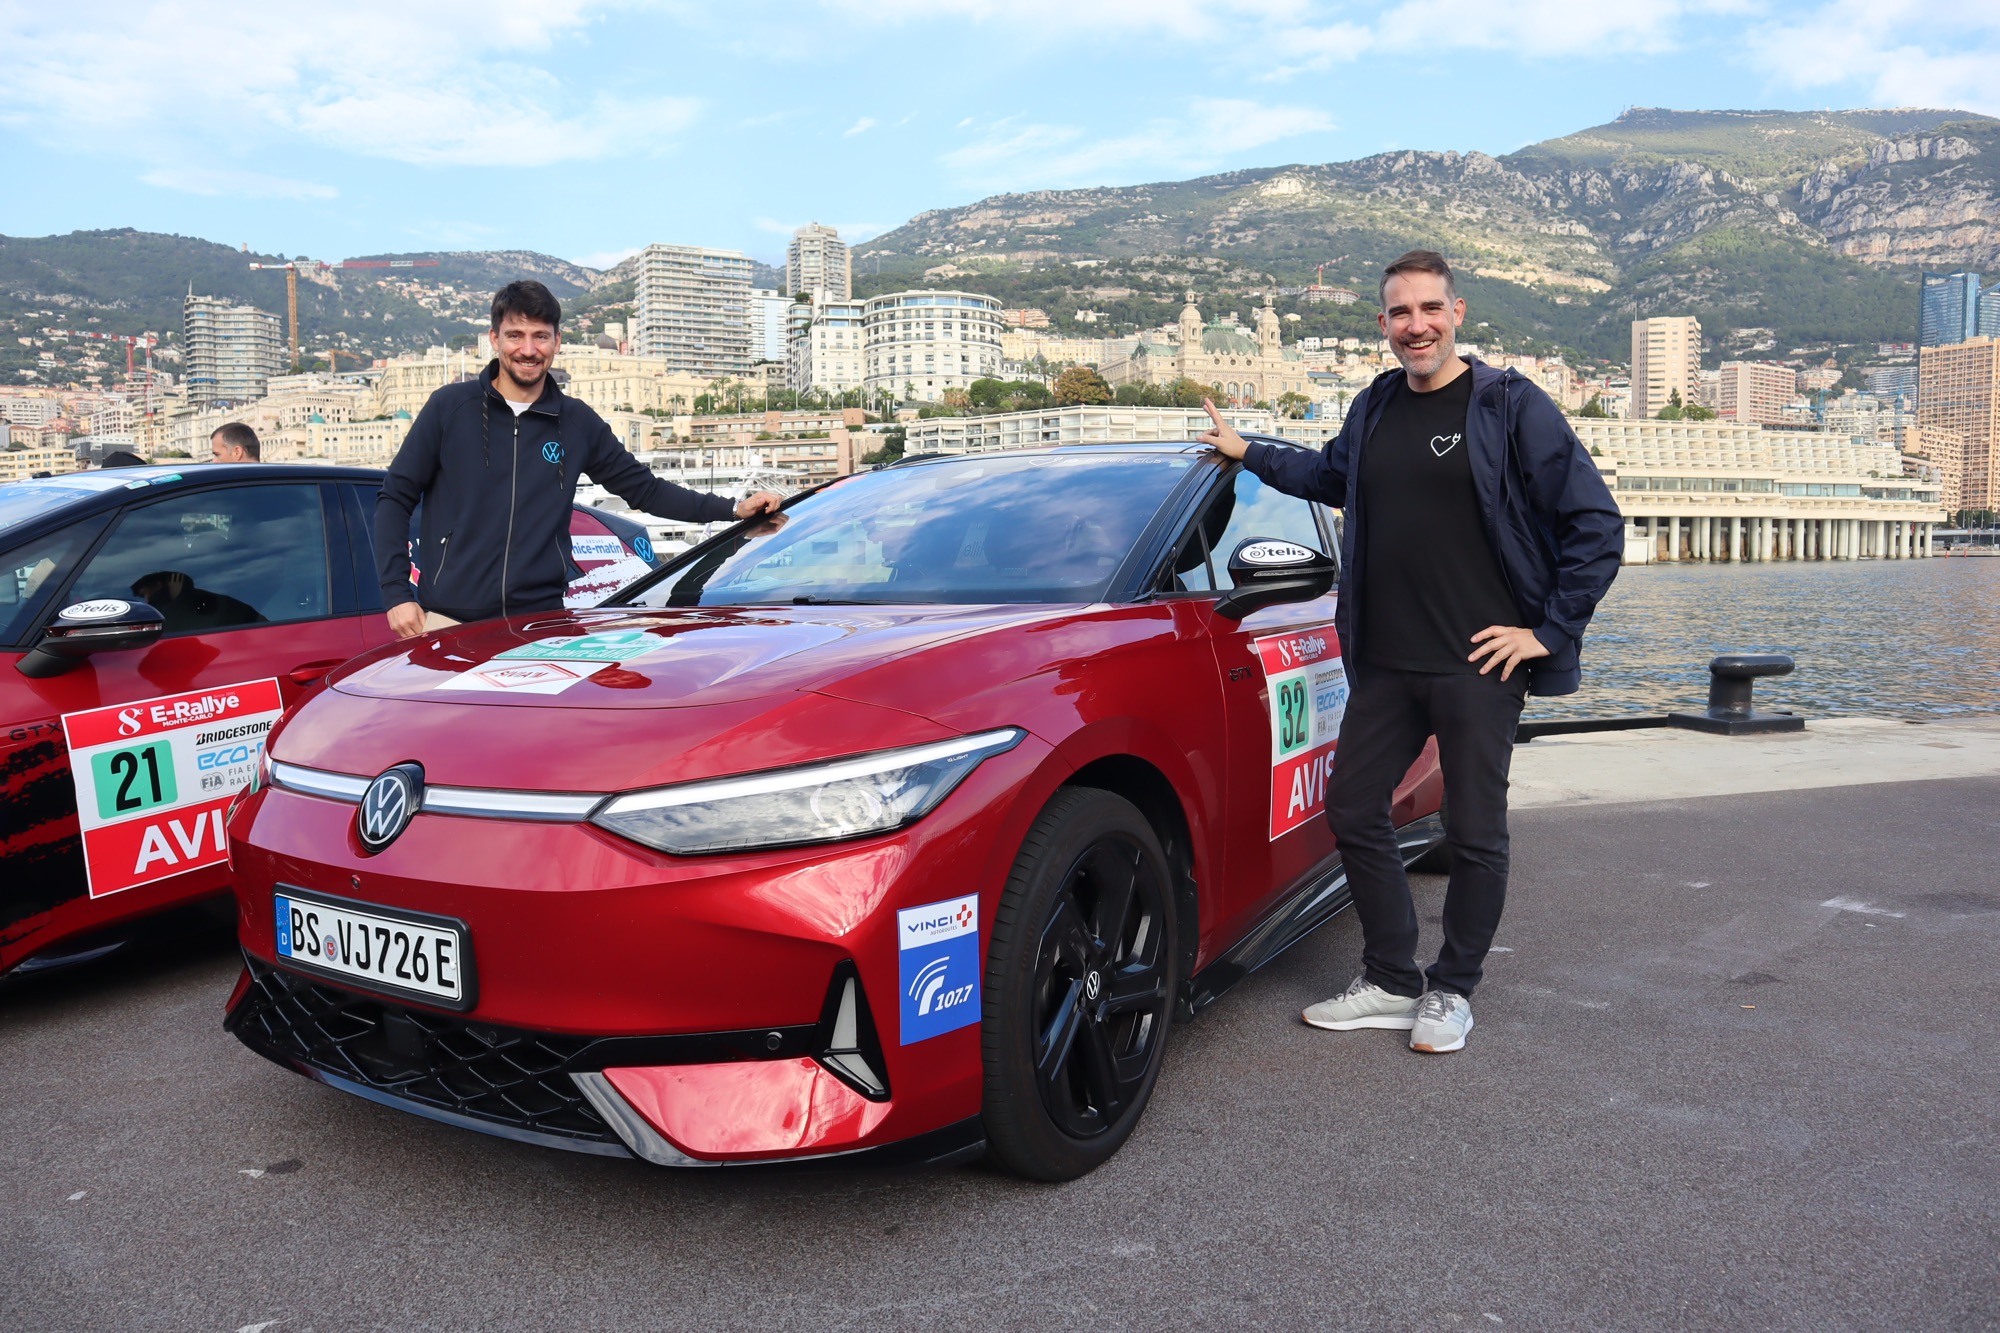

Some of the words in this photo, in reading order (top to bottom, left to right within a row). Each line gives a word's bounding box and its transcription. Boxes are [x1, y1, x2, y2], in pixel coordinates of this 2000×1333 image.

[572, 542, 623, 555] nice-matin
[1290, 635, 1327, 657] E-Rallye
[1229, 666, 1252, 681] GTX
[1315, 667, 1344, 685] BRIDGESTONE
[150, 695, 240, 723] E-Rallye
[1281, 681, 1306, 748] 32
[162, 712, 213, 727] MONTE-CARLO
[9, 723, 62, 741] GTX
[196, 720, 272, 745] BRIDGESTONE
[111, 746, 162, 812] 21
[228, 767, 243, 776] FIA
[230, 775, 251, 786] RALL
[133, 808, 226, 875] AVI
[291, 906, 320, 956] BS
[907, 915, 953, 932] VINCI
[930, 925, 958, 936] AUTOROUTES
[281, 932, 288, 945] D
[934, 984, 974, 1011] 107.7
